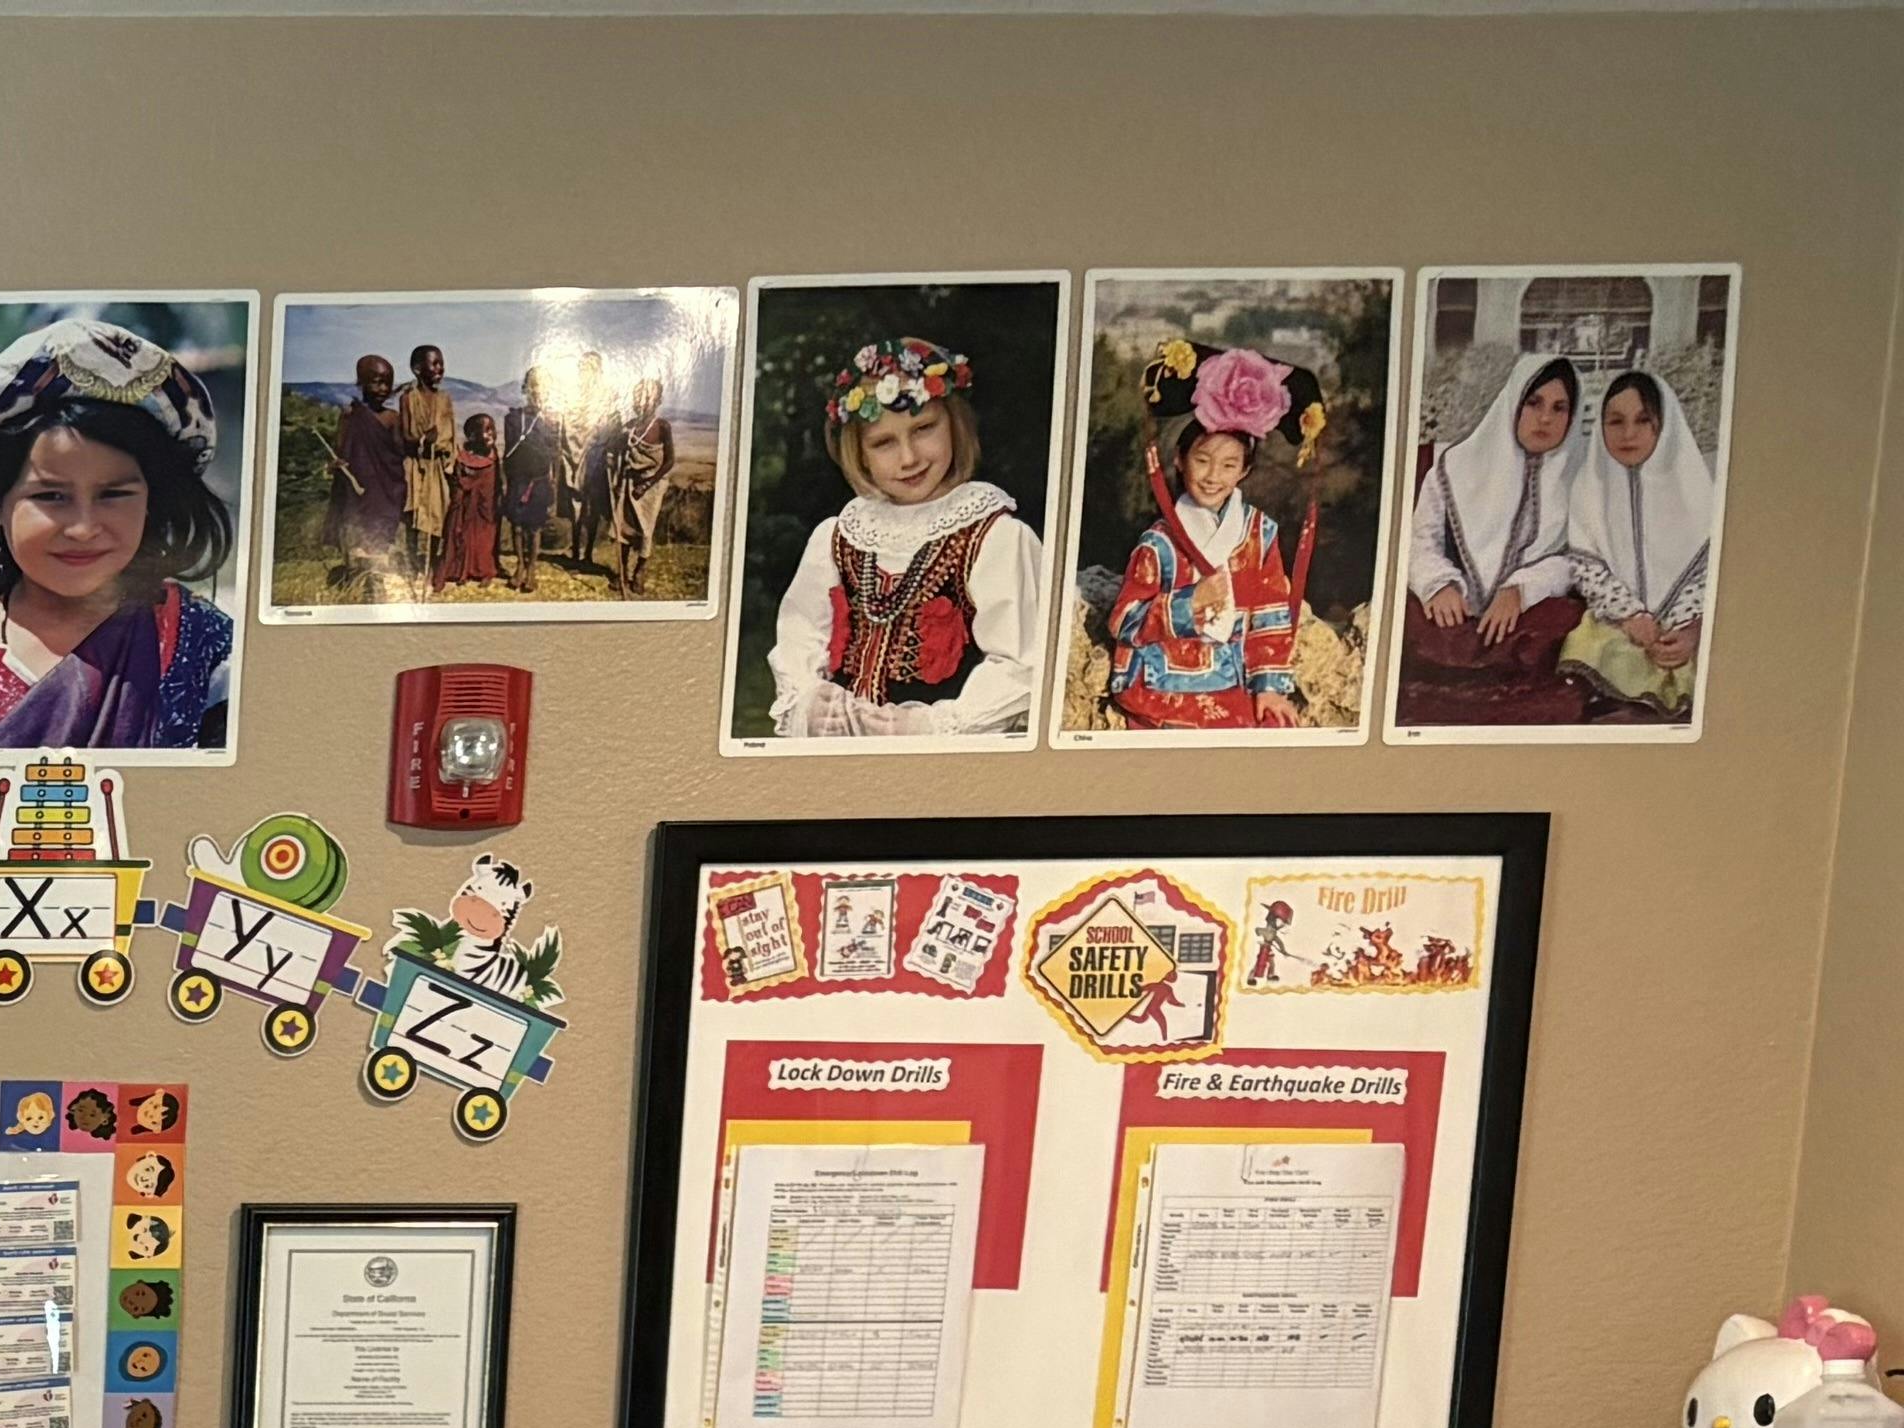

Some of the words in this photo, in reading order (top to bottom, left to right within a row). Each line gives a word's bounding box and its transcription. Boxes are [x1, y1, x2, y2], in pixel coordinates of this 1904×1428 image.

[1318, 886, 1355, 914] Fire
[1359, 886, 1407, 915] Drill
[1086, 926, 1134, 943] SCHOOL
[1070, 946, 1148, 972] SAFETY
[3, 877, 88, 939] Xx
[218, 898, 294, 990] Yy
[405, 982, 494, 1071] Zz
[1070, 973, 1144, 999] DRILLS
[778, 1062, 819, 1082] Lock
[824, 1065, 883, 1084] Down
[889, 1065, 943, 1086] Drills
[1163, 1072, 1201, 1091] Fire
[1206, 1074, 1222, 1091] &
[1230, 1074, 1346, 1096] Earthquake
[1351, 1077, 1403, 1095] Drills
